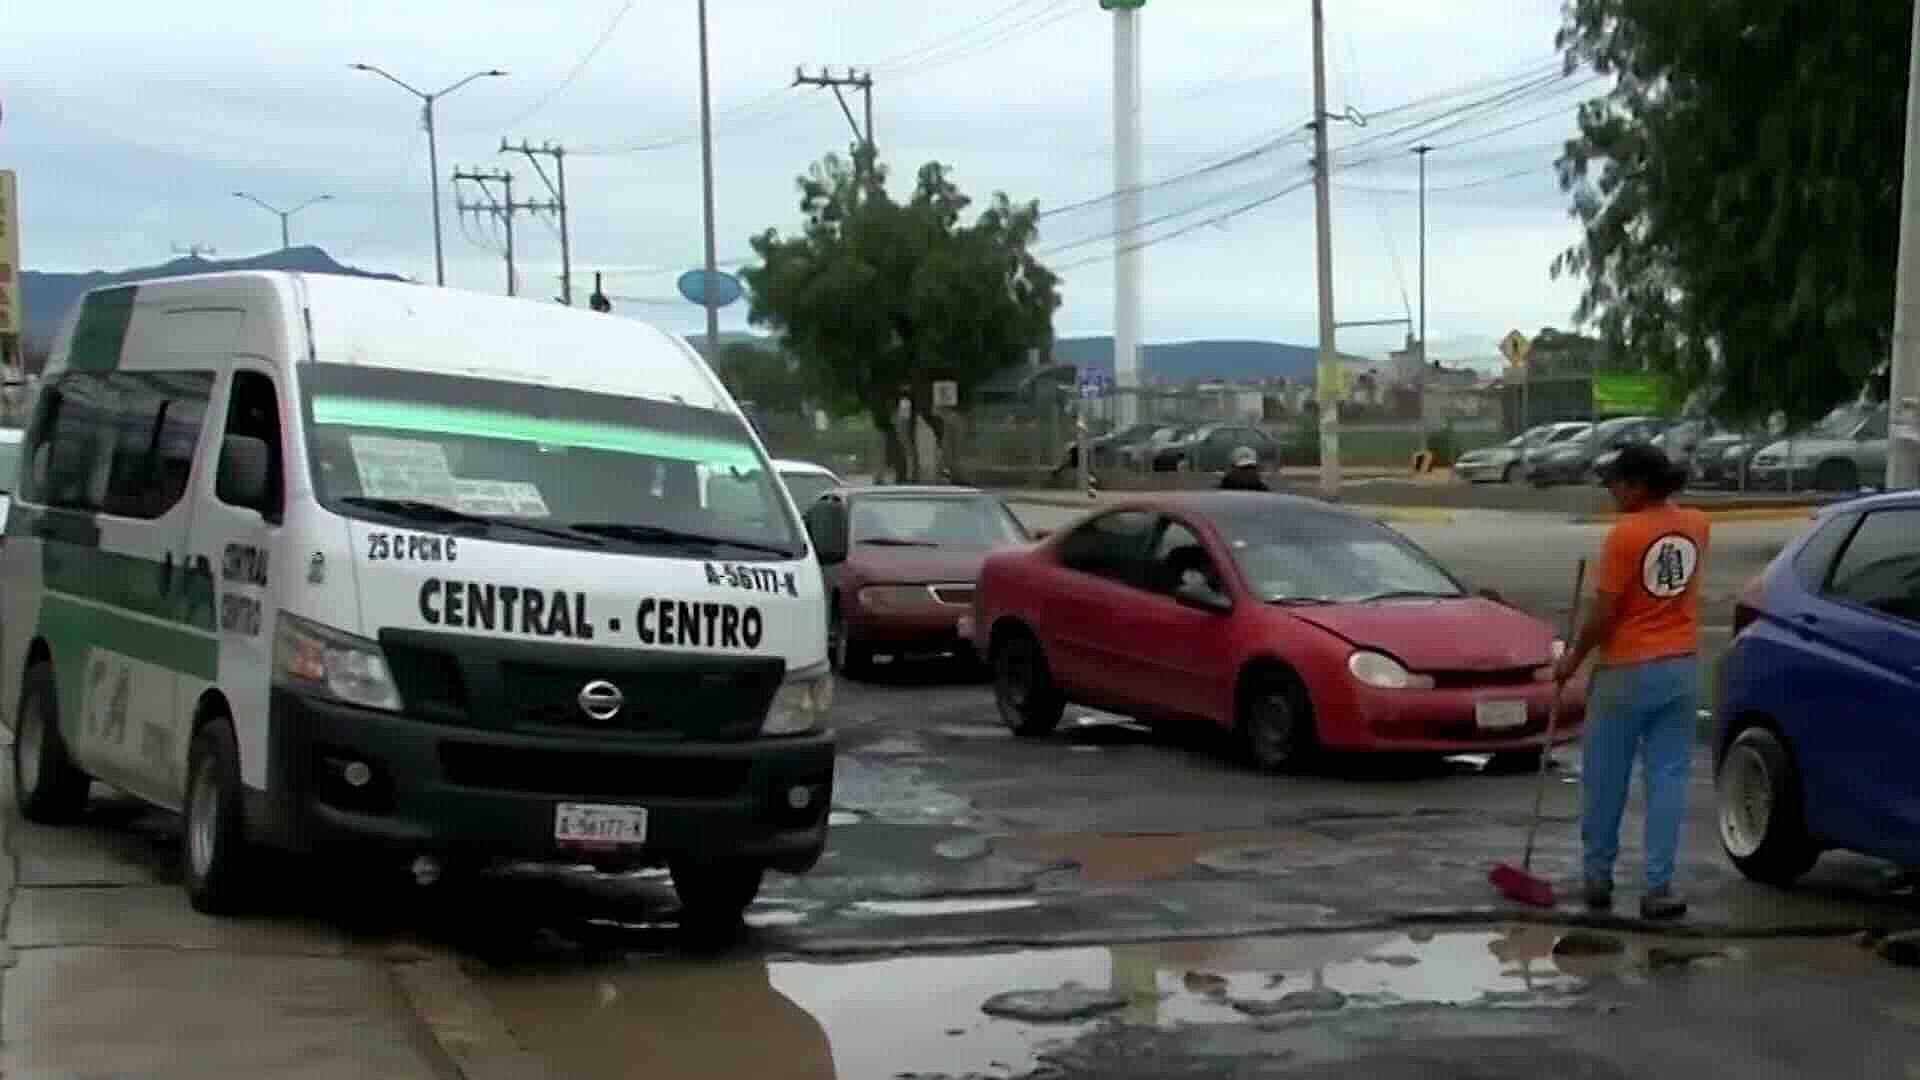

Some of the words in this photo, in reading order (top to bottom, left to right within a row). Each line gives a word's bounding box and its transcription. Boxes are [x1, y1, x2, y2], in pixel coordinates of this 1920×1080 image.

[368, 533, 389, 561] 25
[419, 577, 594, 639] CENTRAL
[636, 597, 764, 648] CENTRO
